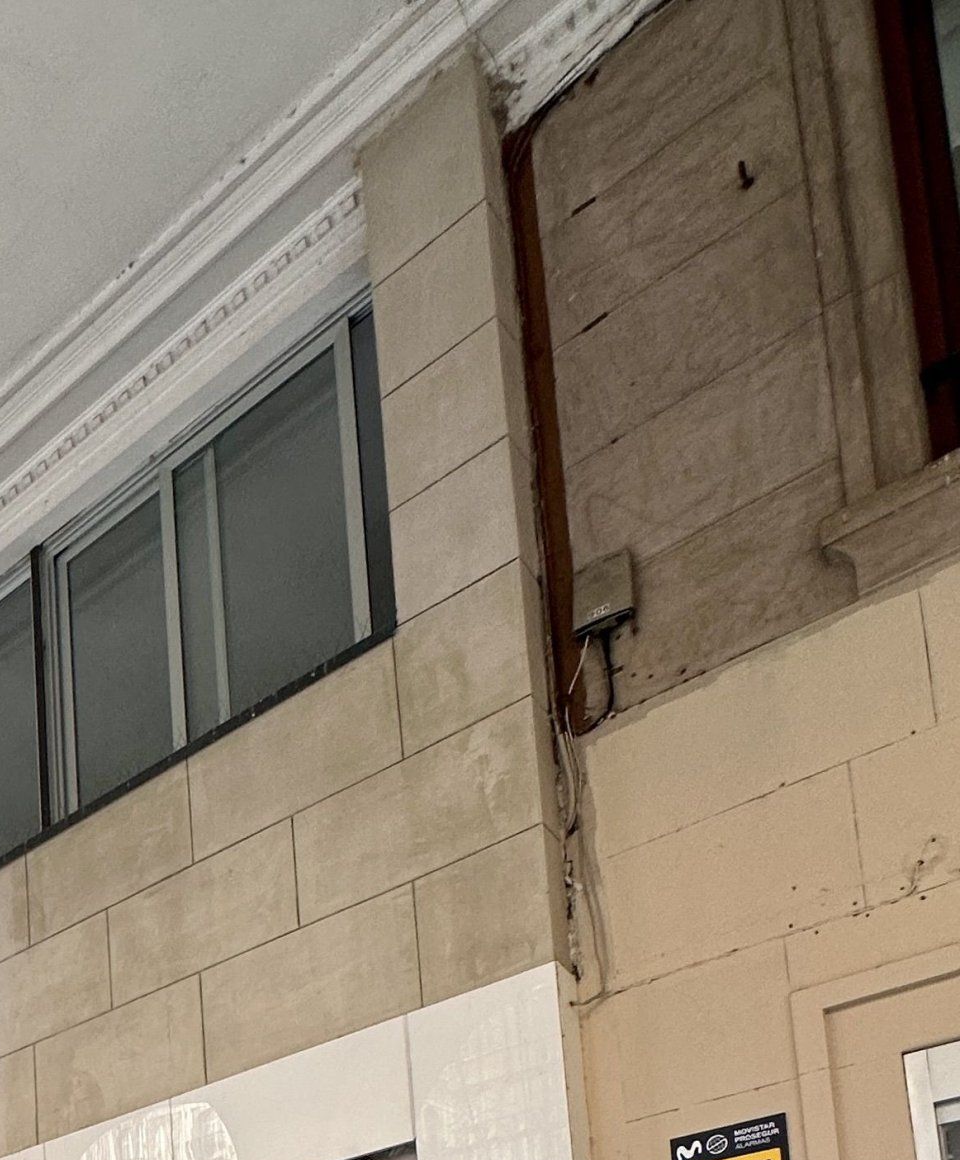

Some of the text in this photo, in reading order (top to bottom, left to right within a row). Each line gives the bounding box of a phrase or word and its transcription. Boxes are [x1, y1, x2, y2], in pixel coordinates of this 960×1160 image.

[734, 1122, 775, 1136] MOVISTAR
[734, 1128, 780, 1143] PROSEGUR
[735, 1137, 771, 1149] ALARMAS
